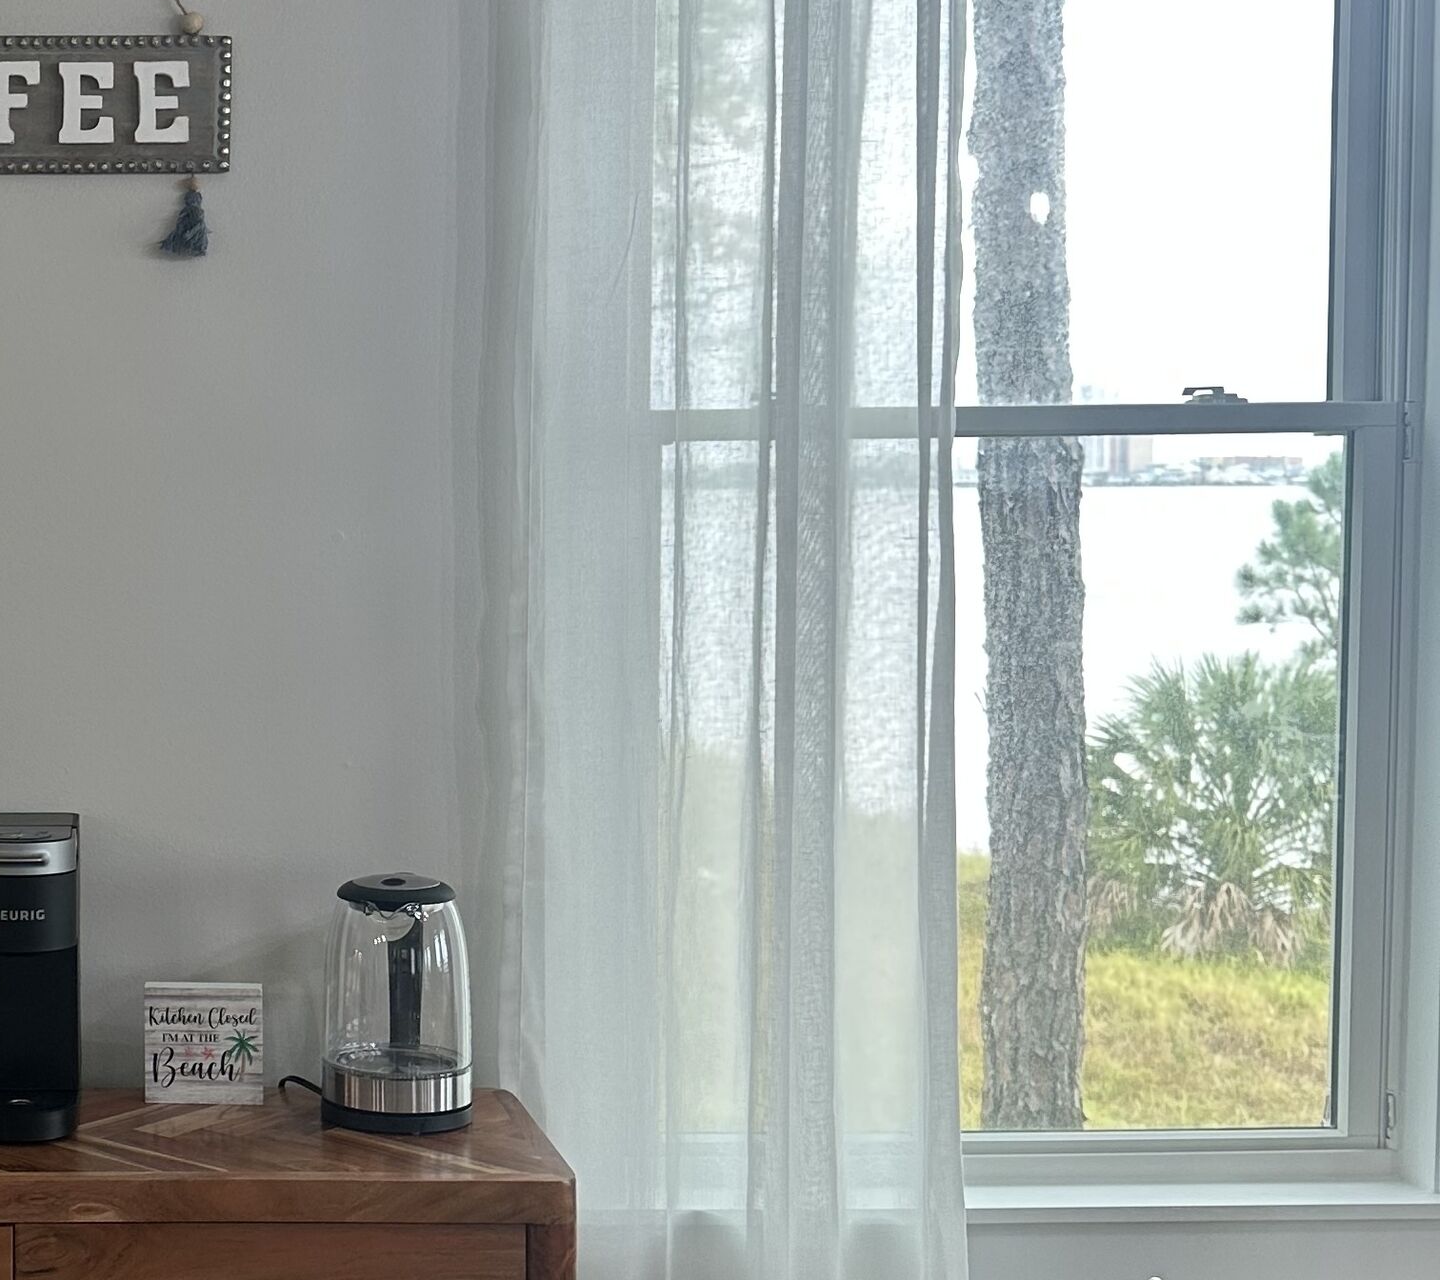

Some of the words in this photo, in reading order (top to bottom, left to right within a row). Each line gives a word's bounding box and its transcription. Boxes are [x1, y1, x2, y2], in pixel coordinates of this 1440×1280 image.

[148, 1005, 205, 1027] Kitchen
[208, 1006, 258, 1029] Closed
[161, 1033, 179, 1043] I'M
[180, 1033, 196, 1043] AT
[198, 1033, 221, 1043] THE
[152, 1046, 241, 1089] Beach
